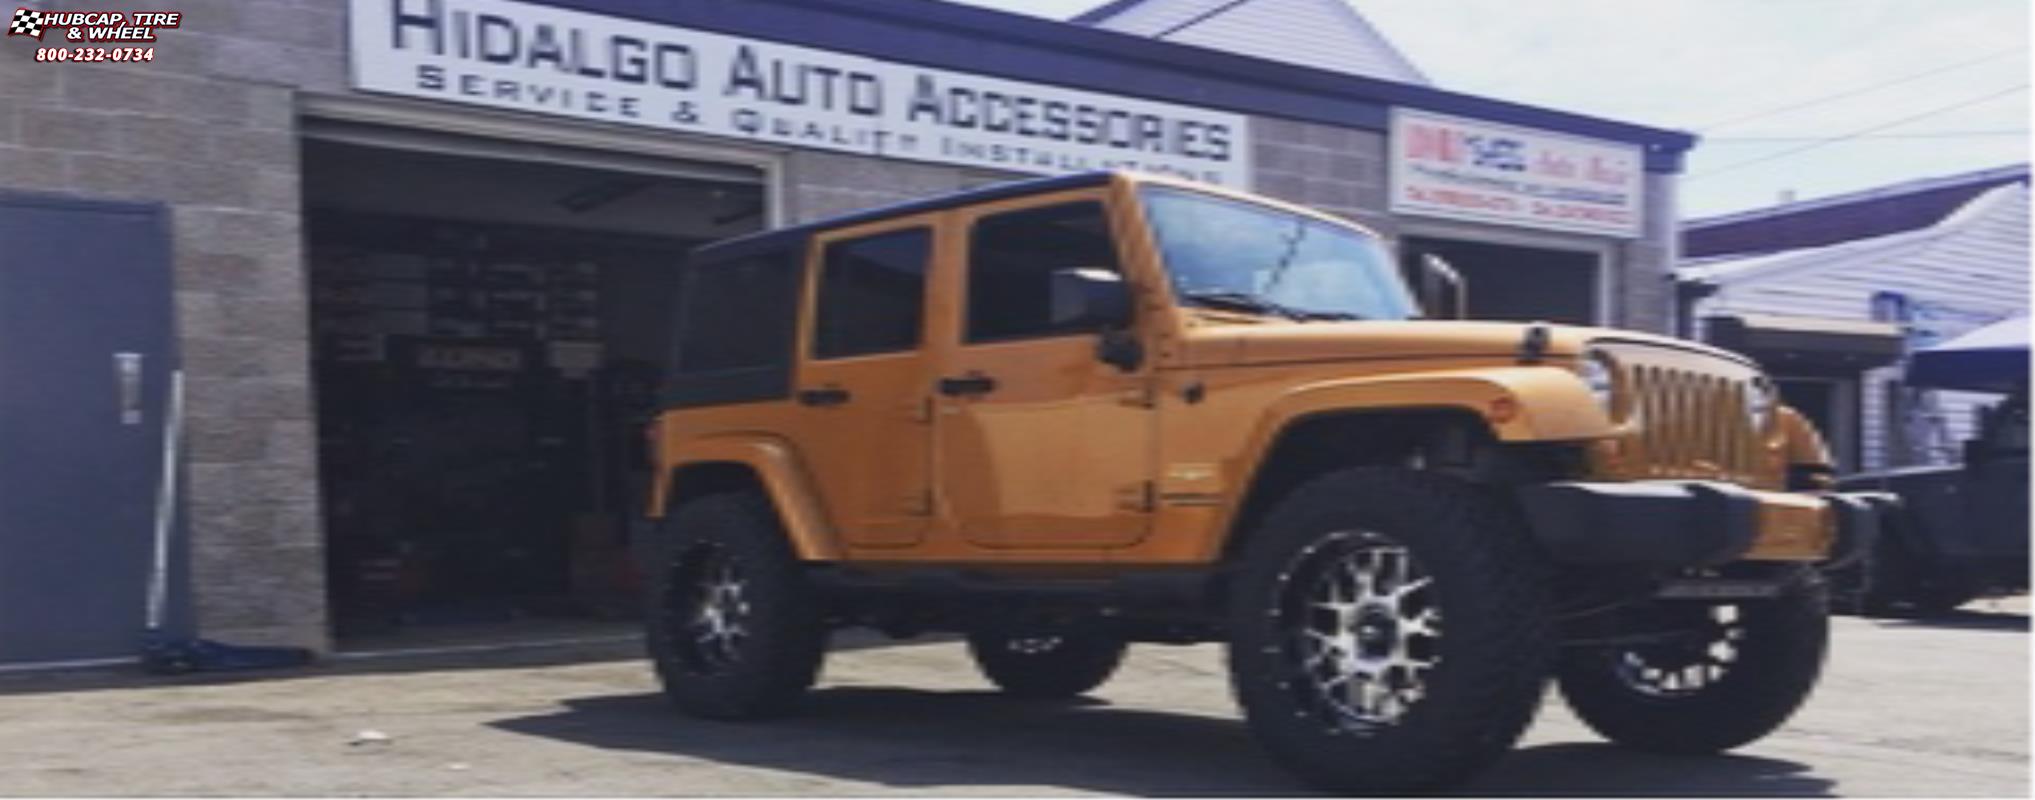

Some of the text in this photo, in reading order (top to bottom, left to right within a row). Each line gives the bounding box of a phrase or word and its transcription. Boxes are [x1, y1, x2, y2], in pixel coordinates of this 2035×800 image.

[390, 0, 1233, 162] HIDALGO AUTO ACCESSORIES
[416, 64, 641, 118] SERVICE
[671, 100, 699, 124] &
